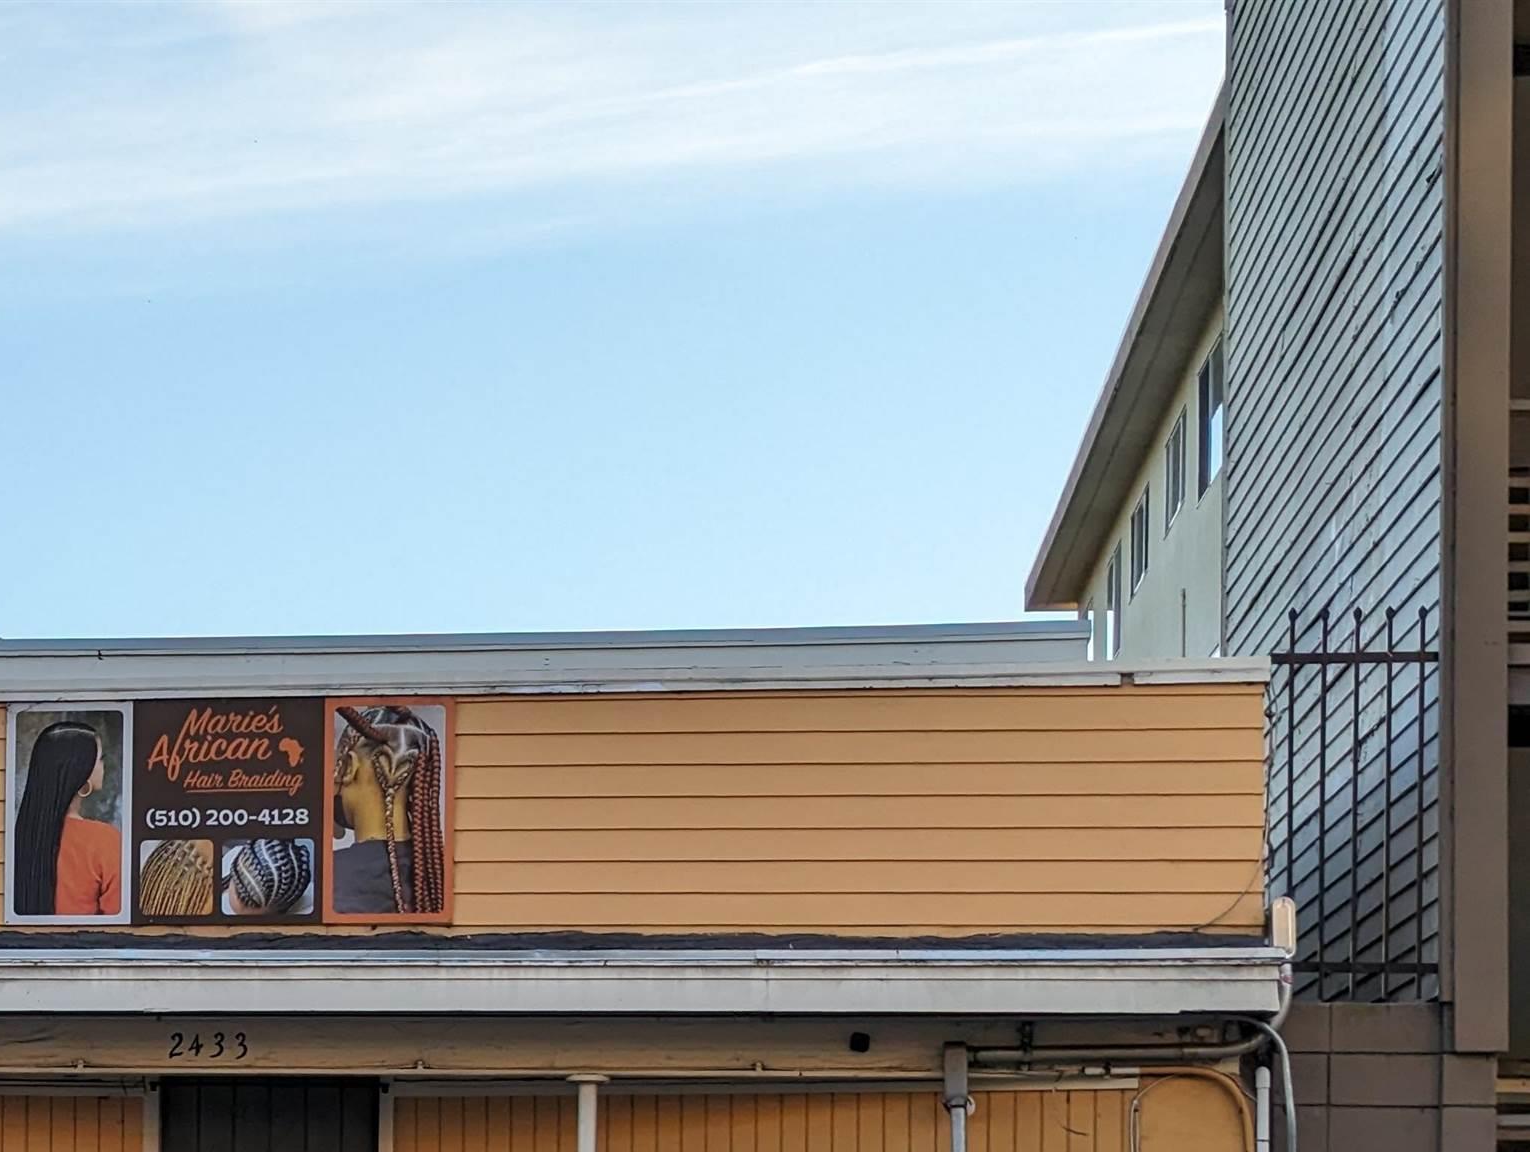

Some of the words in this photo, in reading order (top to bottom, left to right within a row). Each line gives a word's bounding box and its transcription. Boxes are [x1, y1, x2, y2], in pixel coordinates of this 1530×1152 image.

[184, 705, 284, 736] Marie's
[147, 734, 272, 781] African
[183, 770, 224, 788] Hair
[228, 768, 303, 796] Braiding
[146, 807, 201, 829] (510)
[205, 808, 309, 826] 200-4128
[168, 1032, 248, 1060] 2433
